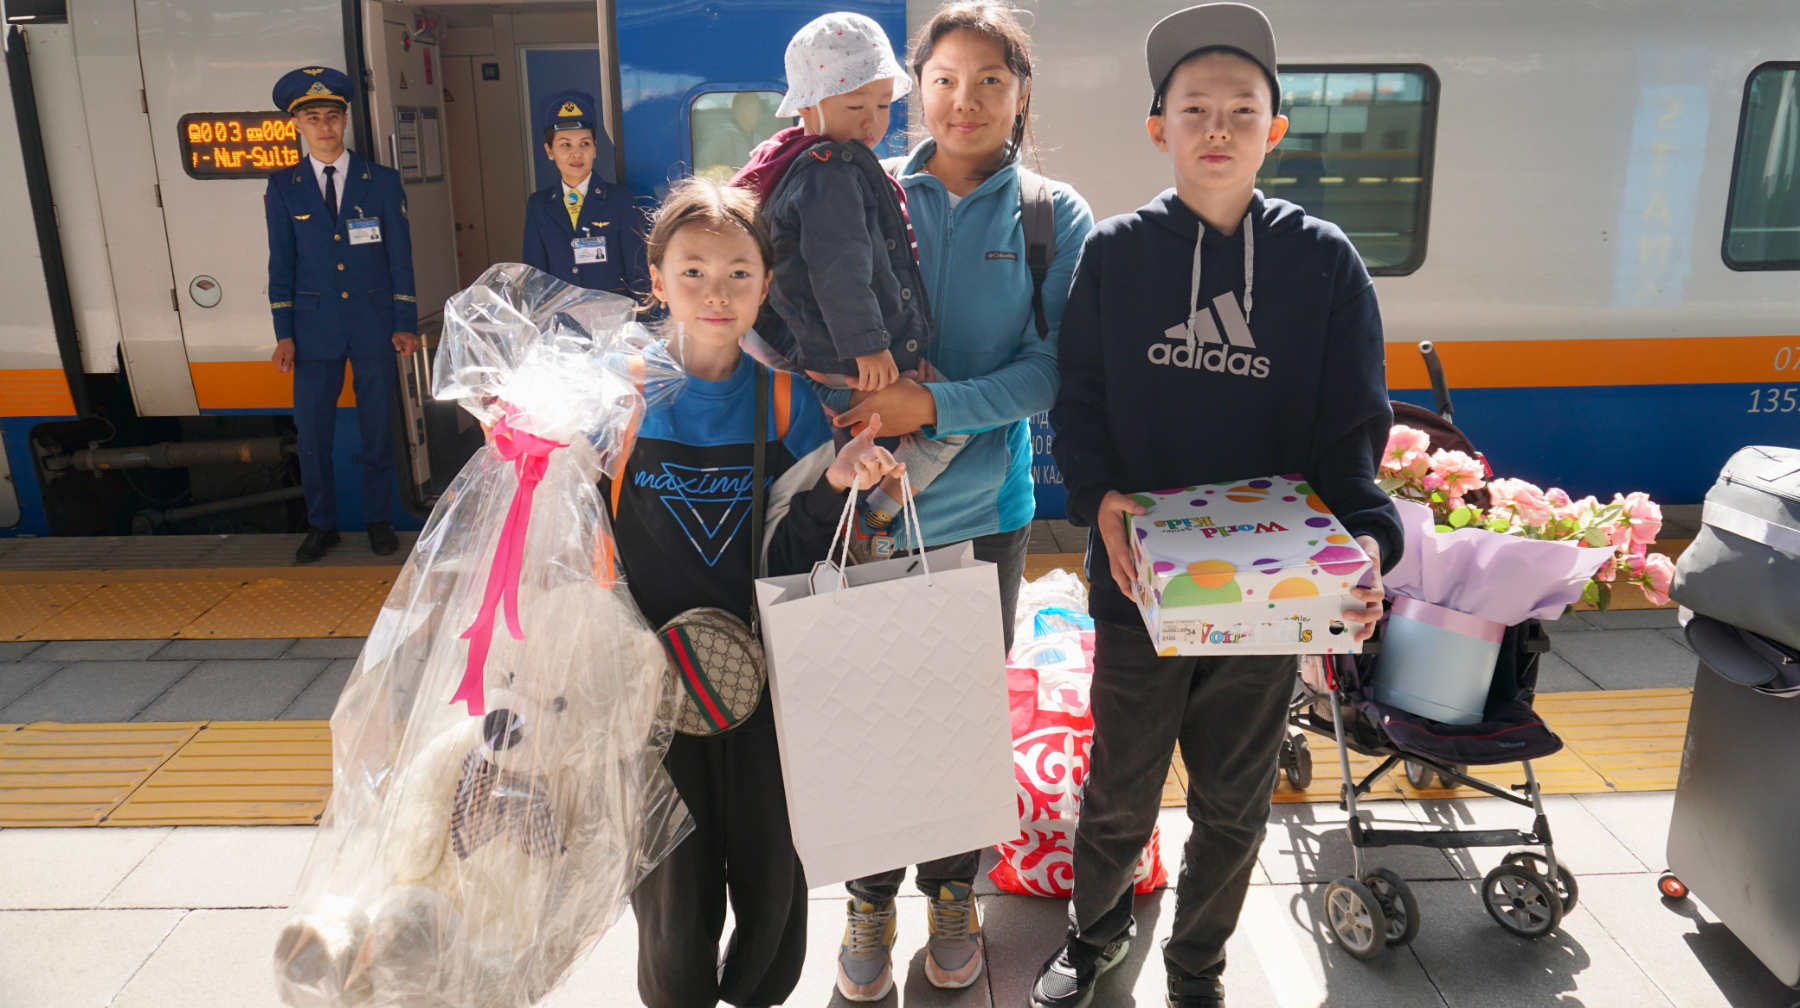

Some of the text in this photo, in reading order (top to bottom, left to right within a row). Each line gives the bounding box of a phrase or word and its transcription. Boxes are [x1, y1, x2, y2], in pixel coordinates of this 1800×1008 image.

[201, 120, 297, 142] 003 004
[1147, 342, 1271, 379] adidas
[1747, 388, 1800, 413] 135
[1153, 516, 1214, 530] Kids
[1200, 521, 1289, 538] World
[1186, 628, 1196, 636] 34
